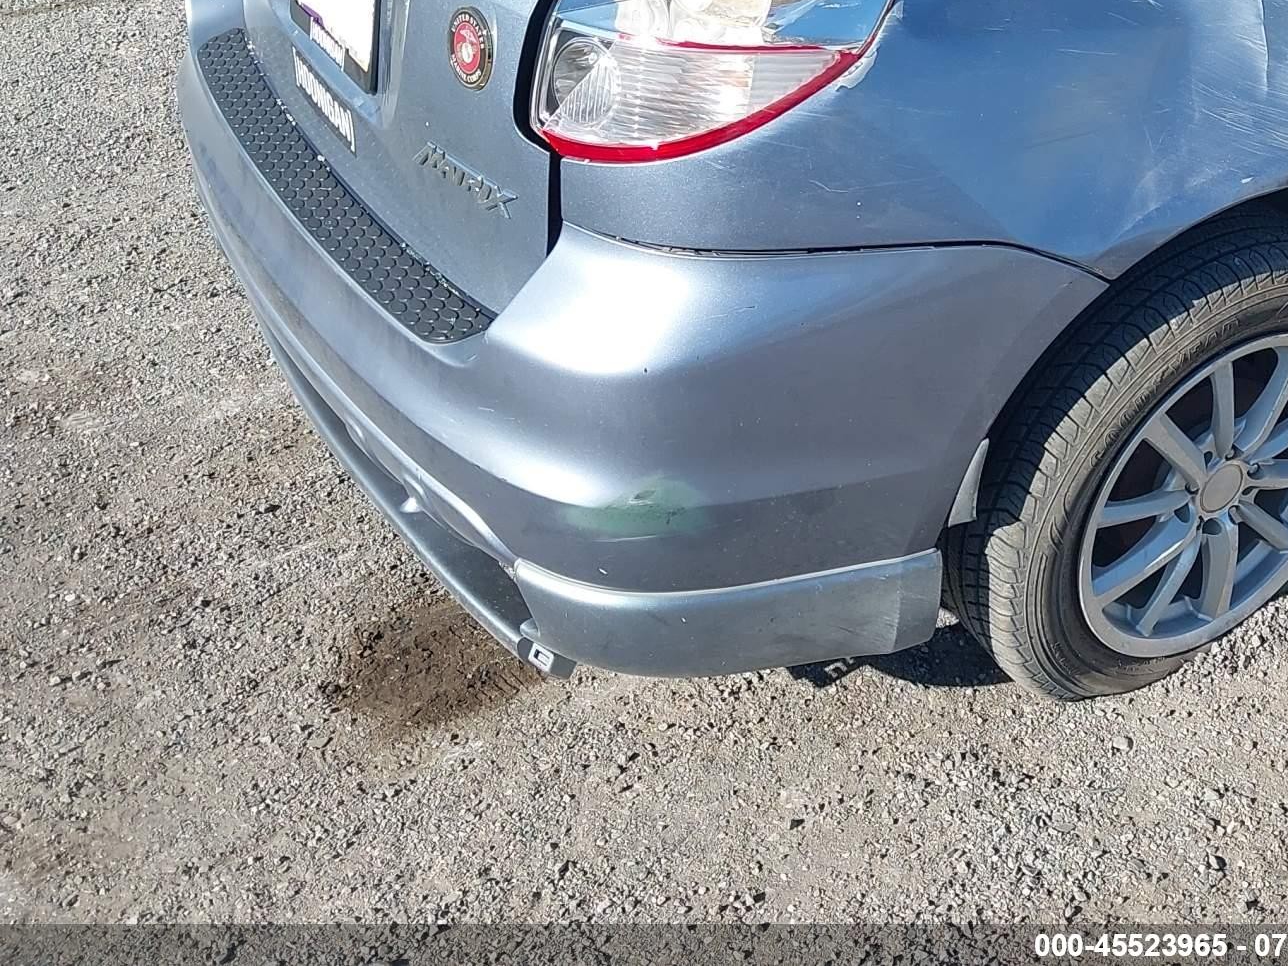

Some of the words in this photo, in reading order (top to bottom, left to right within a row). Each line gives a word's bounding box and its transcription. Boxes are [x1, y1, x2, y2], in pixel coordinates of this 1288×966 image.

[451, 14, 470, 32] UNITED
[470, 18, 485, 49] STATES
[451, 54, 467, 81] MARINE
[466, 68, 481, 83] CORPS
